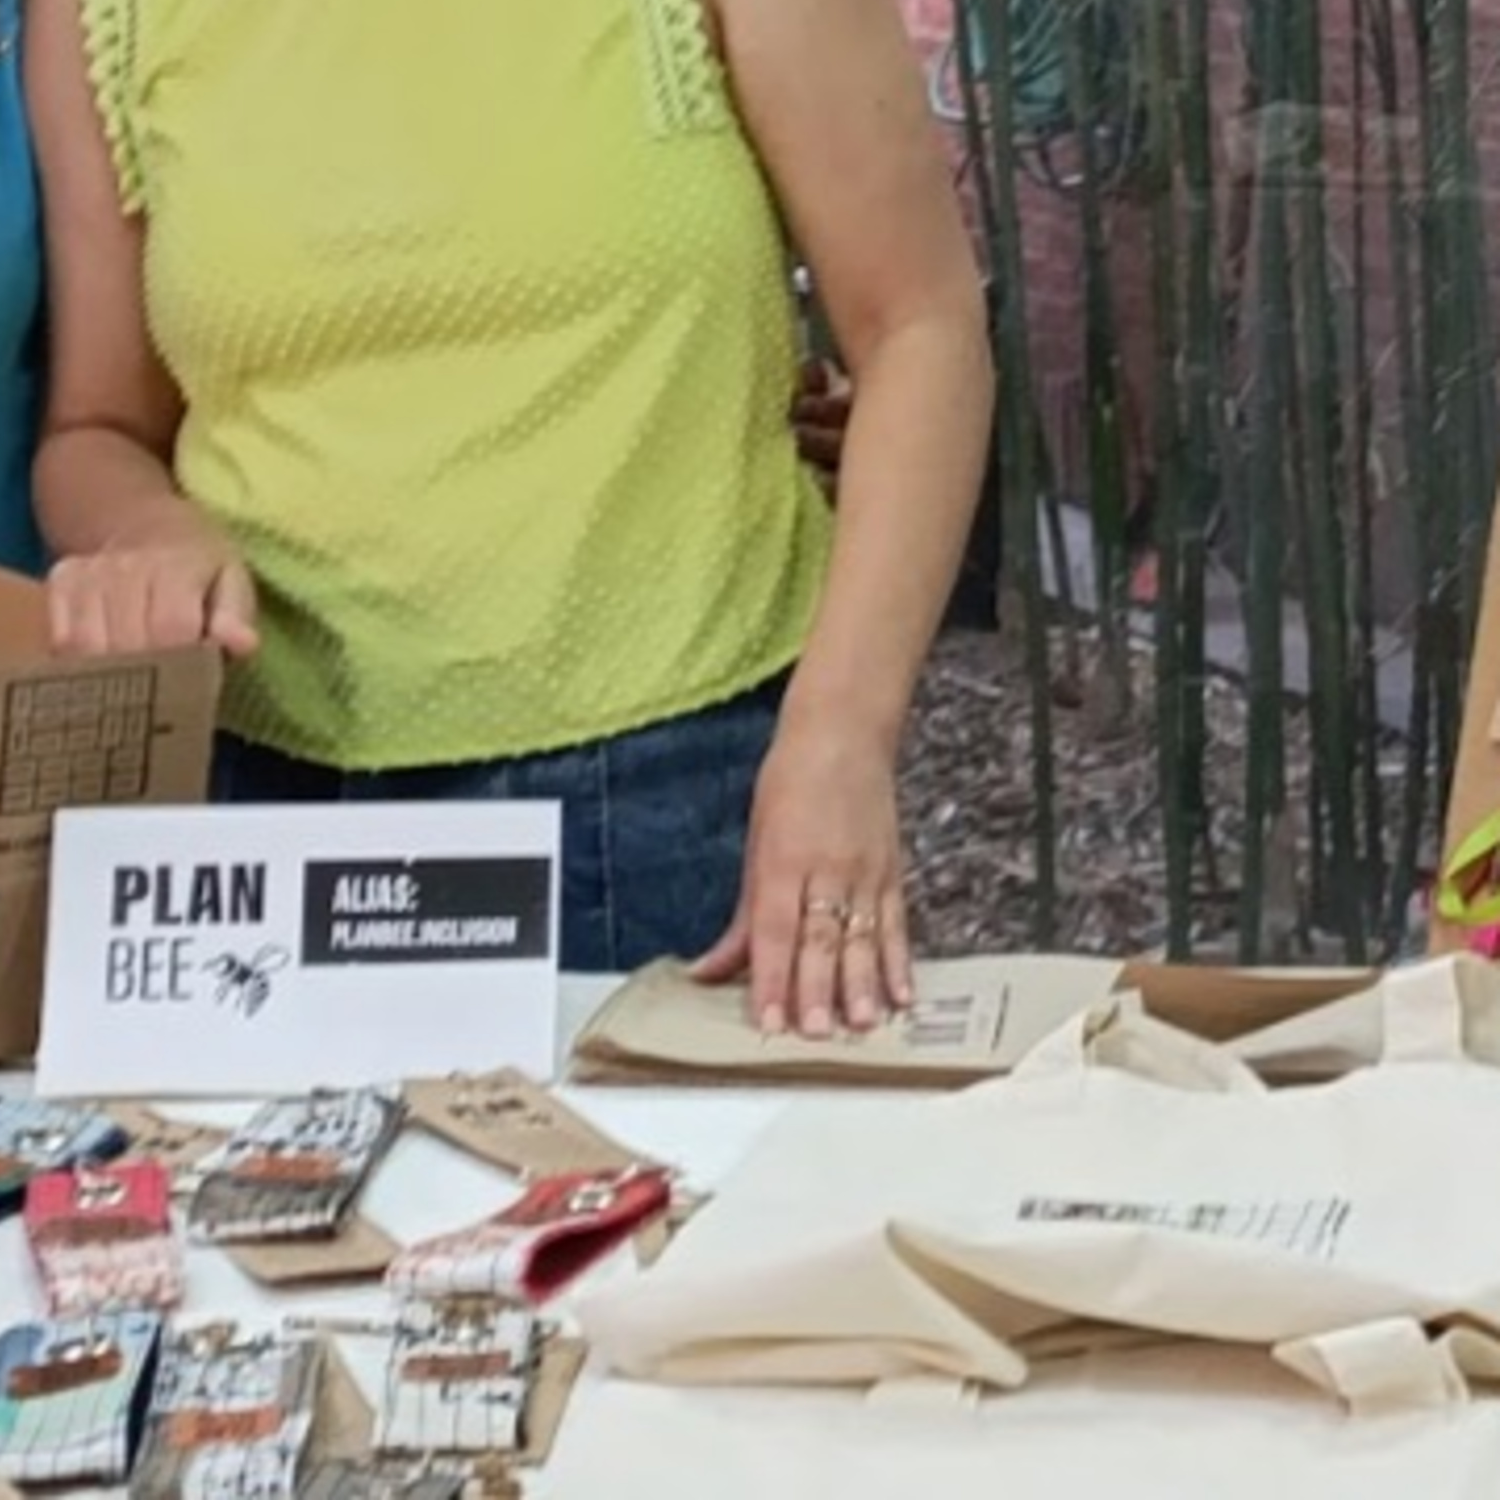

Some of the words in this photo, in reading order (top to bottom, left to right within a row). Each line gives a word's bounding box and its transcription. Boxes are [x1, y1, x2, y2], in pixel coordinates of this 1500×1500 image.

[111, 861, 267, 927] PLAN
[331, 874, 420, 914] ALIAS:
[104, 937, 196, 1002] BEE
